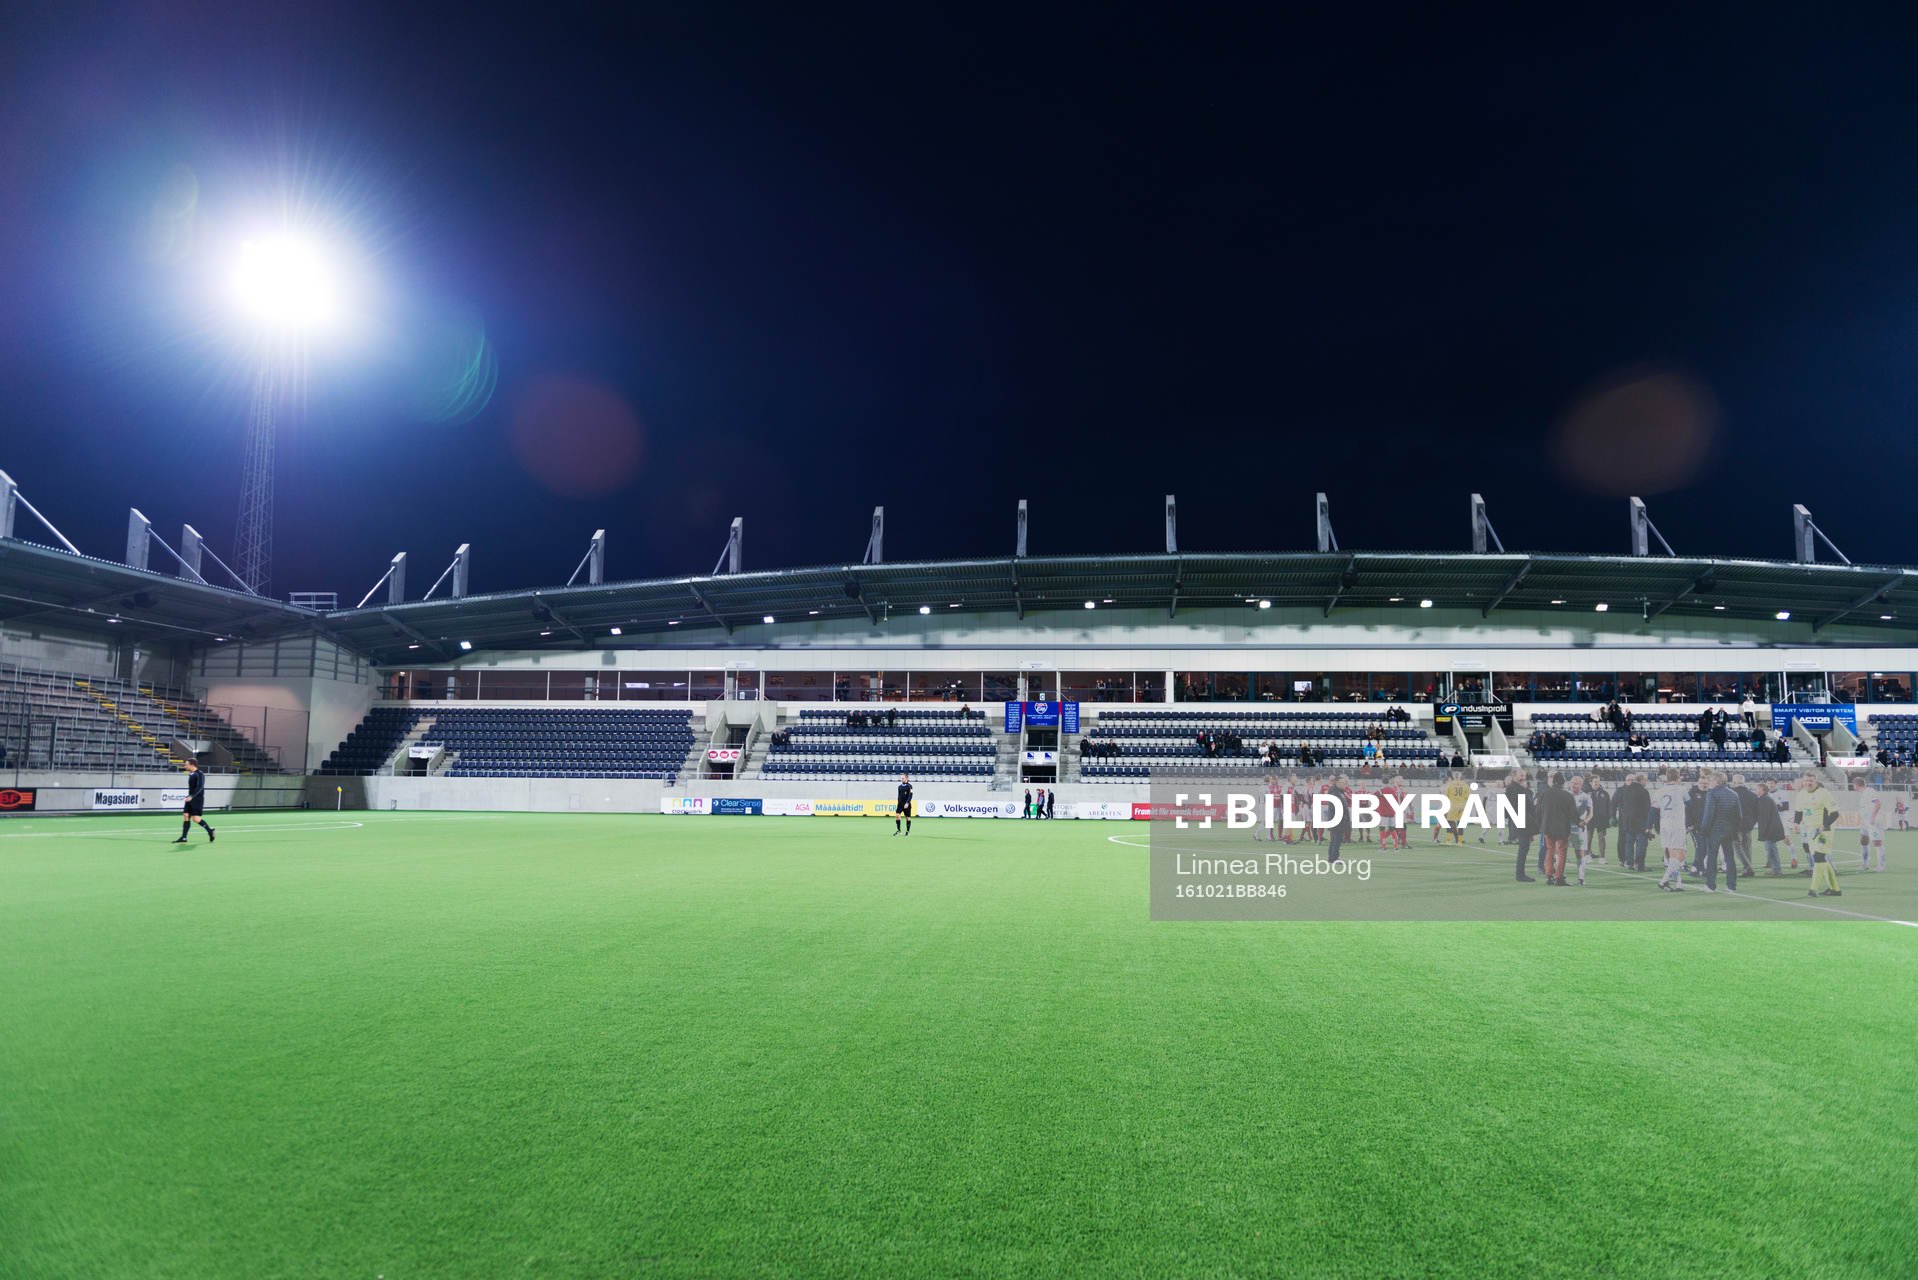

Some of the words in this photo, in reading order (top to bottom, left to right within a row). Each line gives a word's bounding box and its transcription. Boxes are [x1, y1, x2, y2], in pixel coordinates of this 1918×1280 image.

[1453, 786, 1463, 797] 30
[95, 792, 139, 806] Magasinet
[1662, 794, 1673, 811] 2
[795, 803, 810, 811] AGA
[943, 804, 999, 814] Volkswagen
[1134, 807, 1158, 816] Framåt
[1169, 808, 1192, 816] svensk
